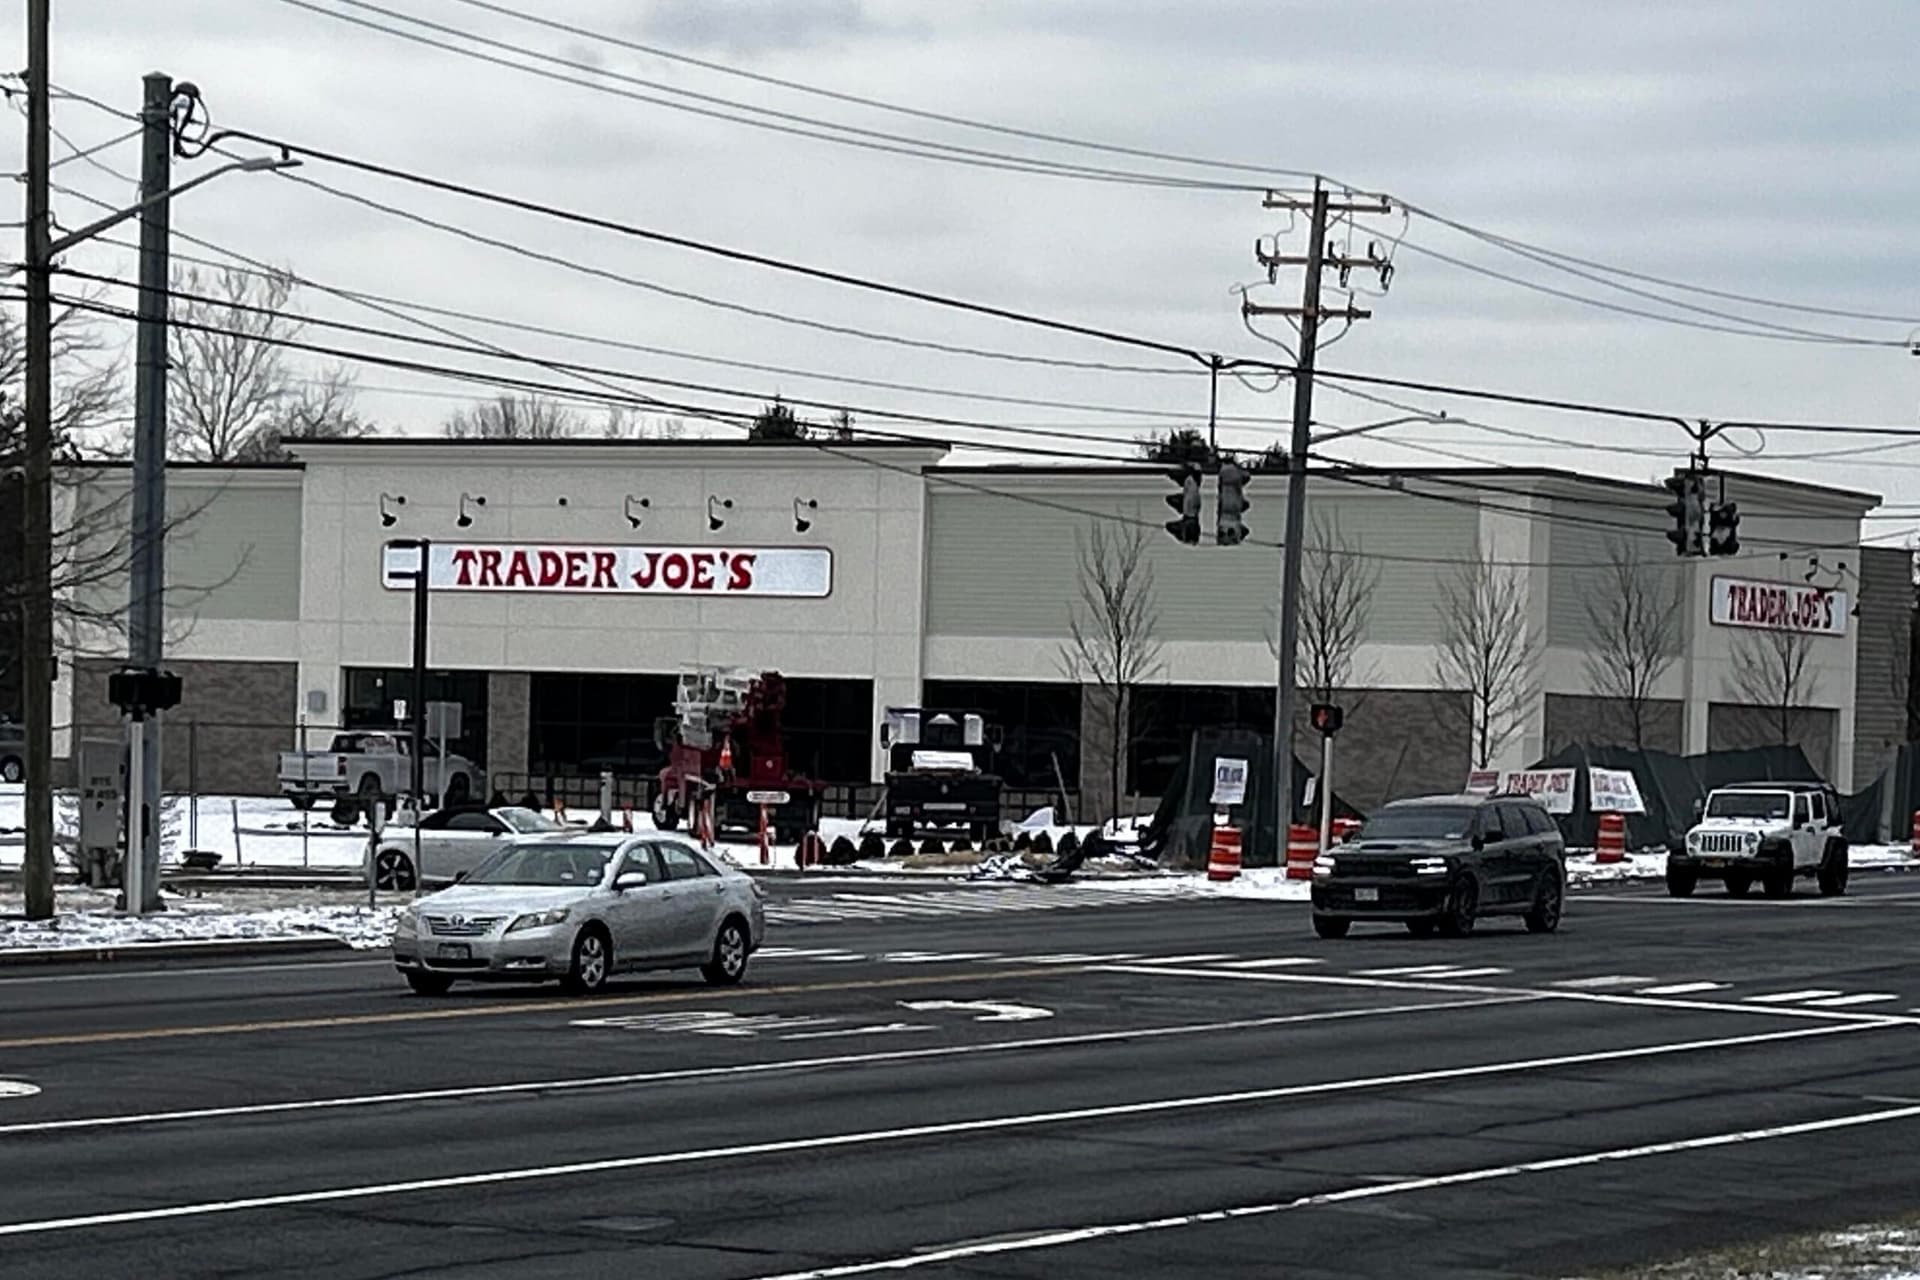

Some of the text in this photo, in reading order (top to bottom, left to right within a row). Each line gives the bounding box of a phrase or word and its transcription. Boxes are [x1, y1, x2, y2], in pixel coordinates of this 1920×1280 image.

[452, 549, 757, 590] TRADER JOE'S
[1728, 585, 1789, 625] TRADER
